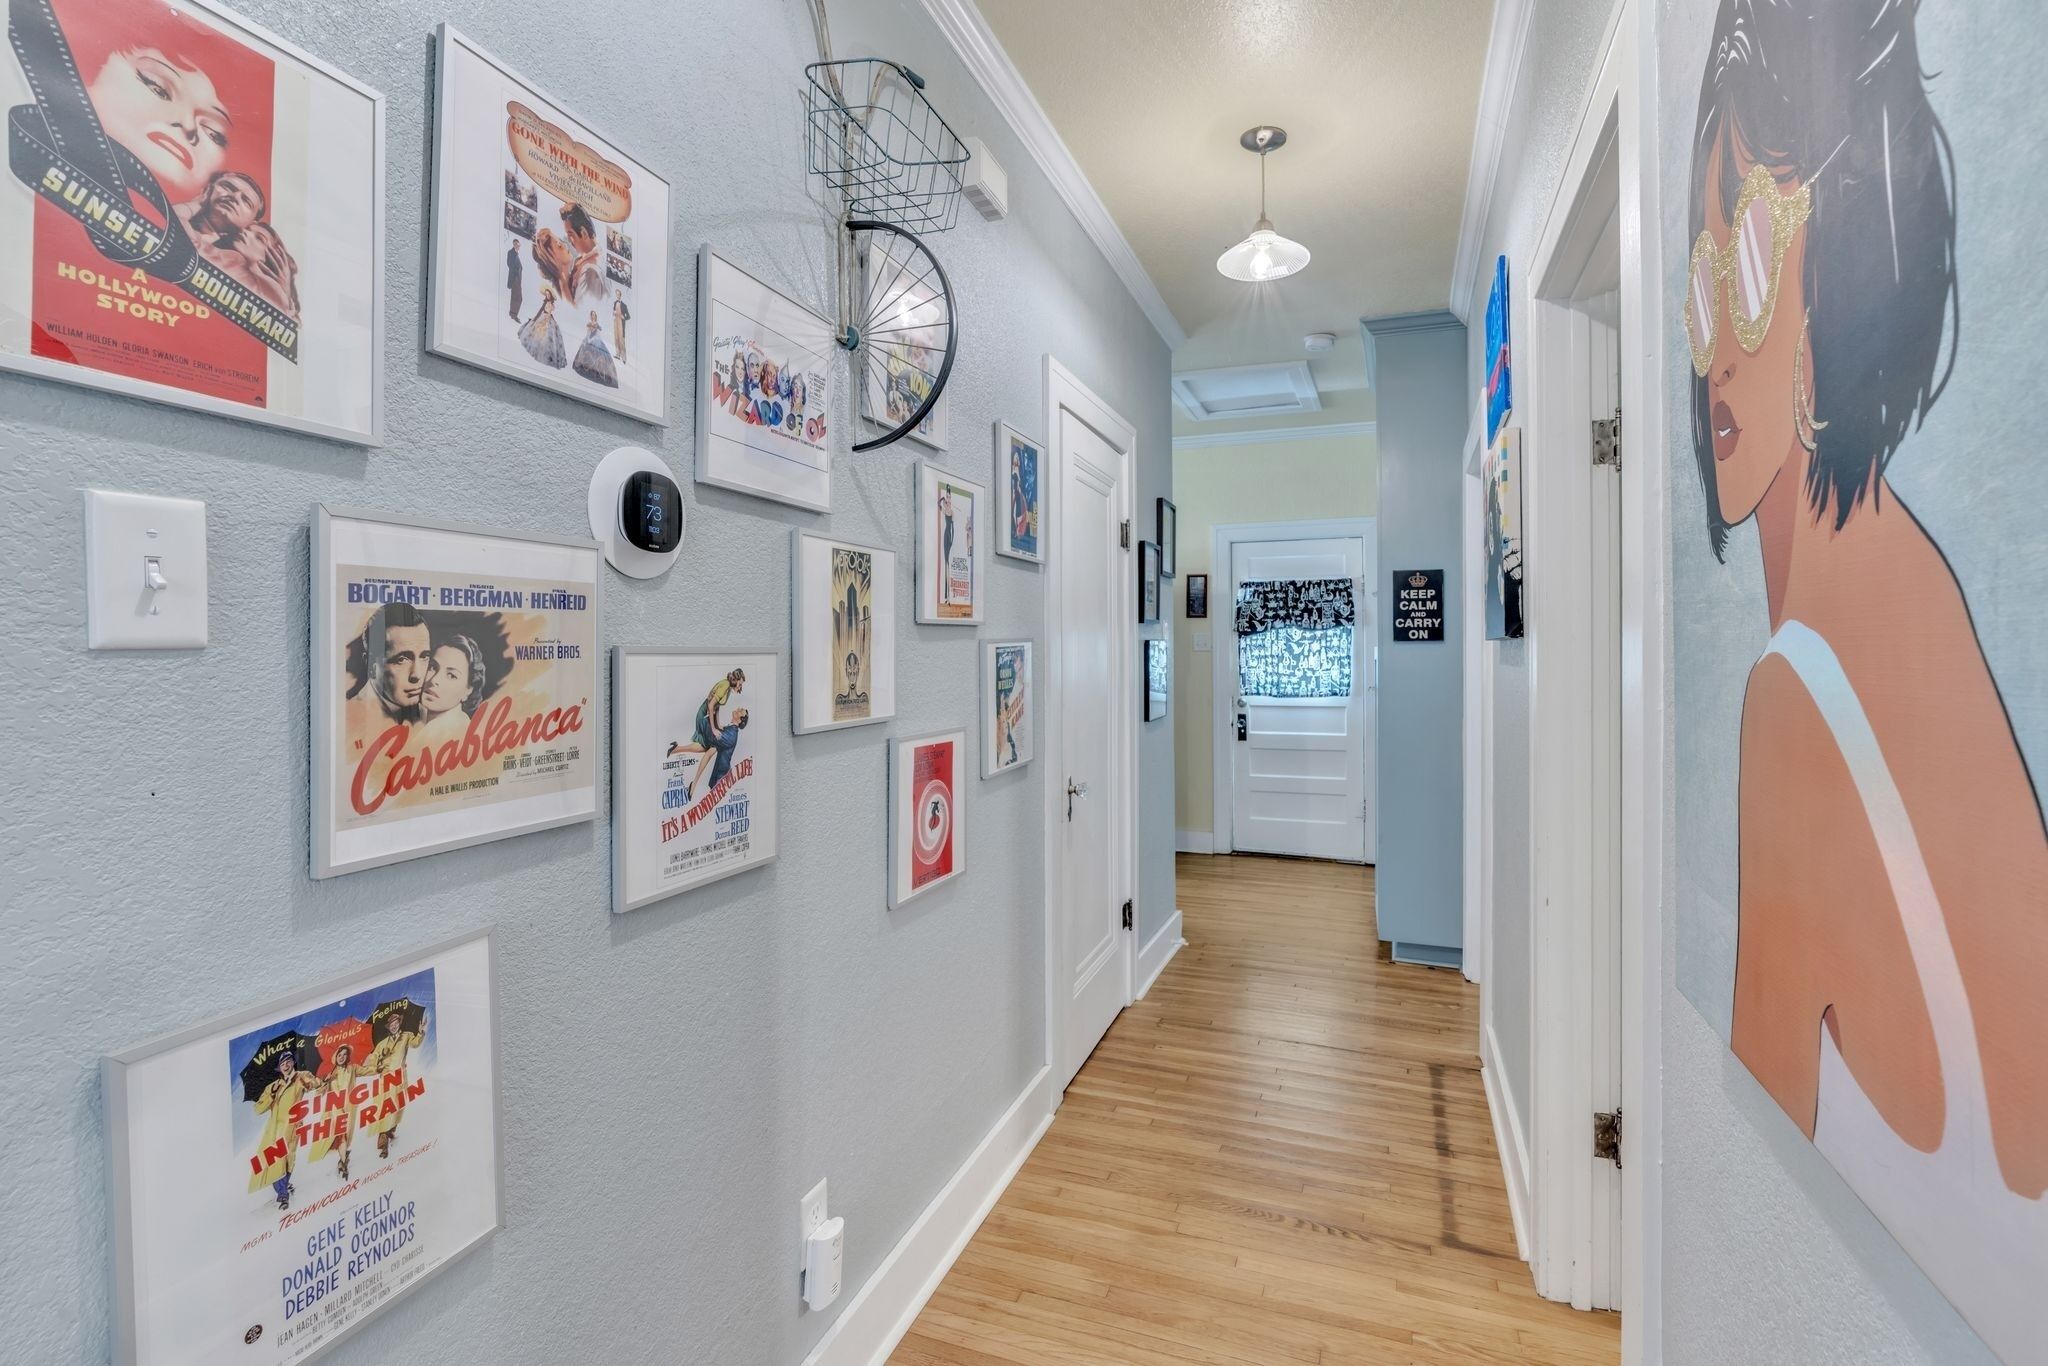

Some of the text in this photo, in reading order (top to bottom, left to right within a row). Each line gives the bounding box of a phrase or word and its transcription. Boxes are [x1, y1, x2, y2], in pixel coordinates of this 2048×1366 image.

[511, 122, 545, 150] GONE
[549, 143, 578, 169] WITH
[582, 165, 600, 184] THE
[604, 178, 629, 200] WIND
[528, 149, 559, 173] HOWARD
[42, 166, 162, 254] SUNSET
[131, 268, 148, 285] A
[57, 261, 211, 320] HOLLYWOOD
[96, 293, 181, 328] STORY
[191, 266, 297, 348] BOULEVARD
[46, 321, 83, 339] WILLIAM
[86, 332, 118, 349] HOLDEN
[122, 342, 149, 356] GLORIA
[152, 348, 189, 366] SWANSON
[714, 360, 730, 375] THE
[712, 371, 784, 428] WIZARD
[806, 412, 827, 443] OZ
[646, 504, 662, 522] 73
[348, 583, 587, 611] BOGART BERGMAN HENREID
[1400, 601, 1437, 610] CALM
[1401, 590, 1436, 599] KEEP
[1396, 618, 1441, 628] CARRY
[1408, 630, 1429, 639] ON
[515, 645, 582, 661] WARNER BROS.
[503, 760, 517, 771] RAINS
[534, 752, 565, 766] GREENSTREET
[567, 750, 580, 761] LORRE
[662, 758, 696, 770] LIBERTY FILMS
[430, 787, 434, 796] A
[435, 786, 444, 796] HAL
[450, 782, 468, 793] WALLIS
[469, 777, 499, 790] PRODUCTION
[668, 778, 684, 789] Frank
[680, 814, 689, 834] A
[687, 769, 736, 828] WONDERFUL
[736, 758, 753, 781] LIFE
[729, 793, 747, 803] James
[715, 800, 750, 825] STEWART
[715, 818, 750, 841] Donna REED
[253, 998, 409, 1066] What a Glorious Feeling
[250, 1077, 426, 1176] IN THE RAIN
[279, 1179, 360, 1232] TECHNICOLOR
[362, 1164, 394, 1186] MUSICAL
[307, 1190, 393, 1257] GENE KELLY
[282, 1200, 416, 1298] DONALD O'CONNOR
[286, 1222, 416, 1321] DEBBIE REYNOLDS
[278, 1327, 294, 1348] JEAN
[296, 1312, 319, 1335] HAGEN
[324, 1291, 352, 1316] MILLARD
[354, 1270, 383, 1295] MITCHELL
